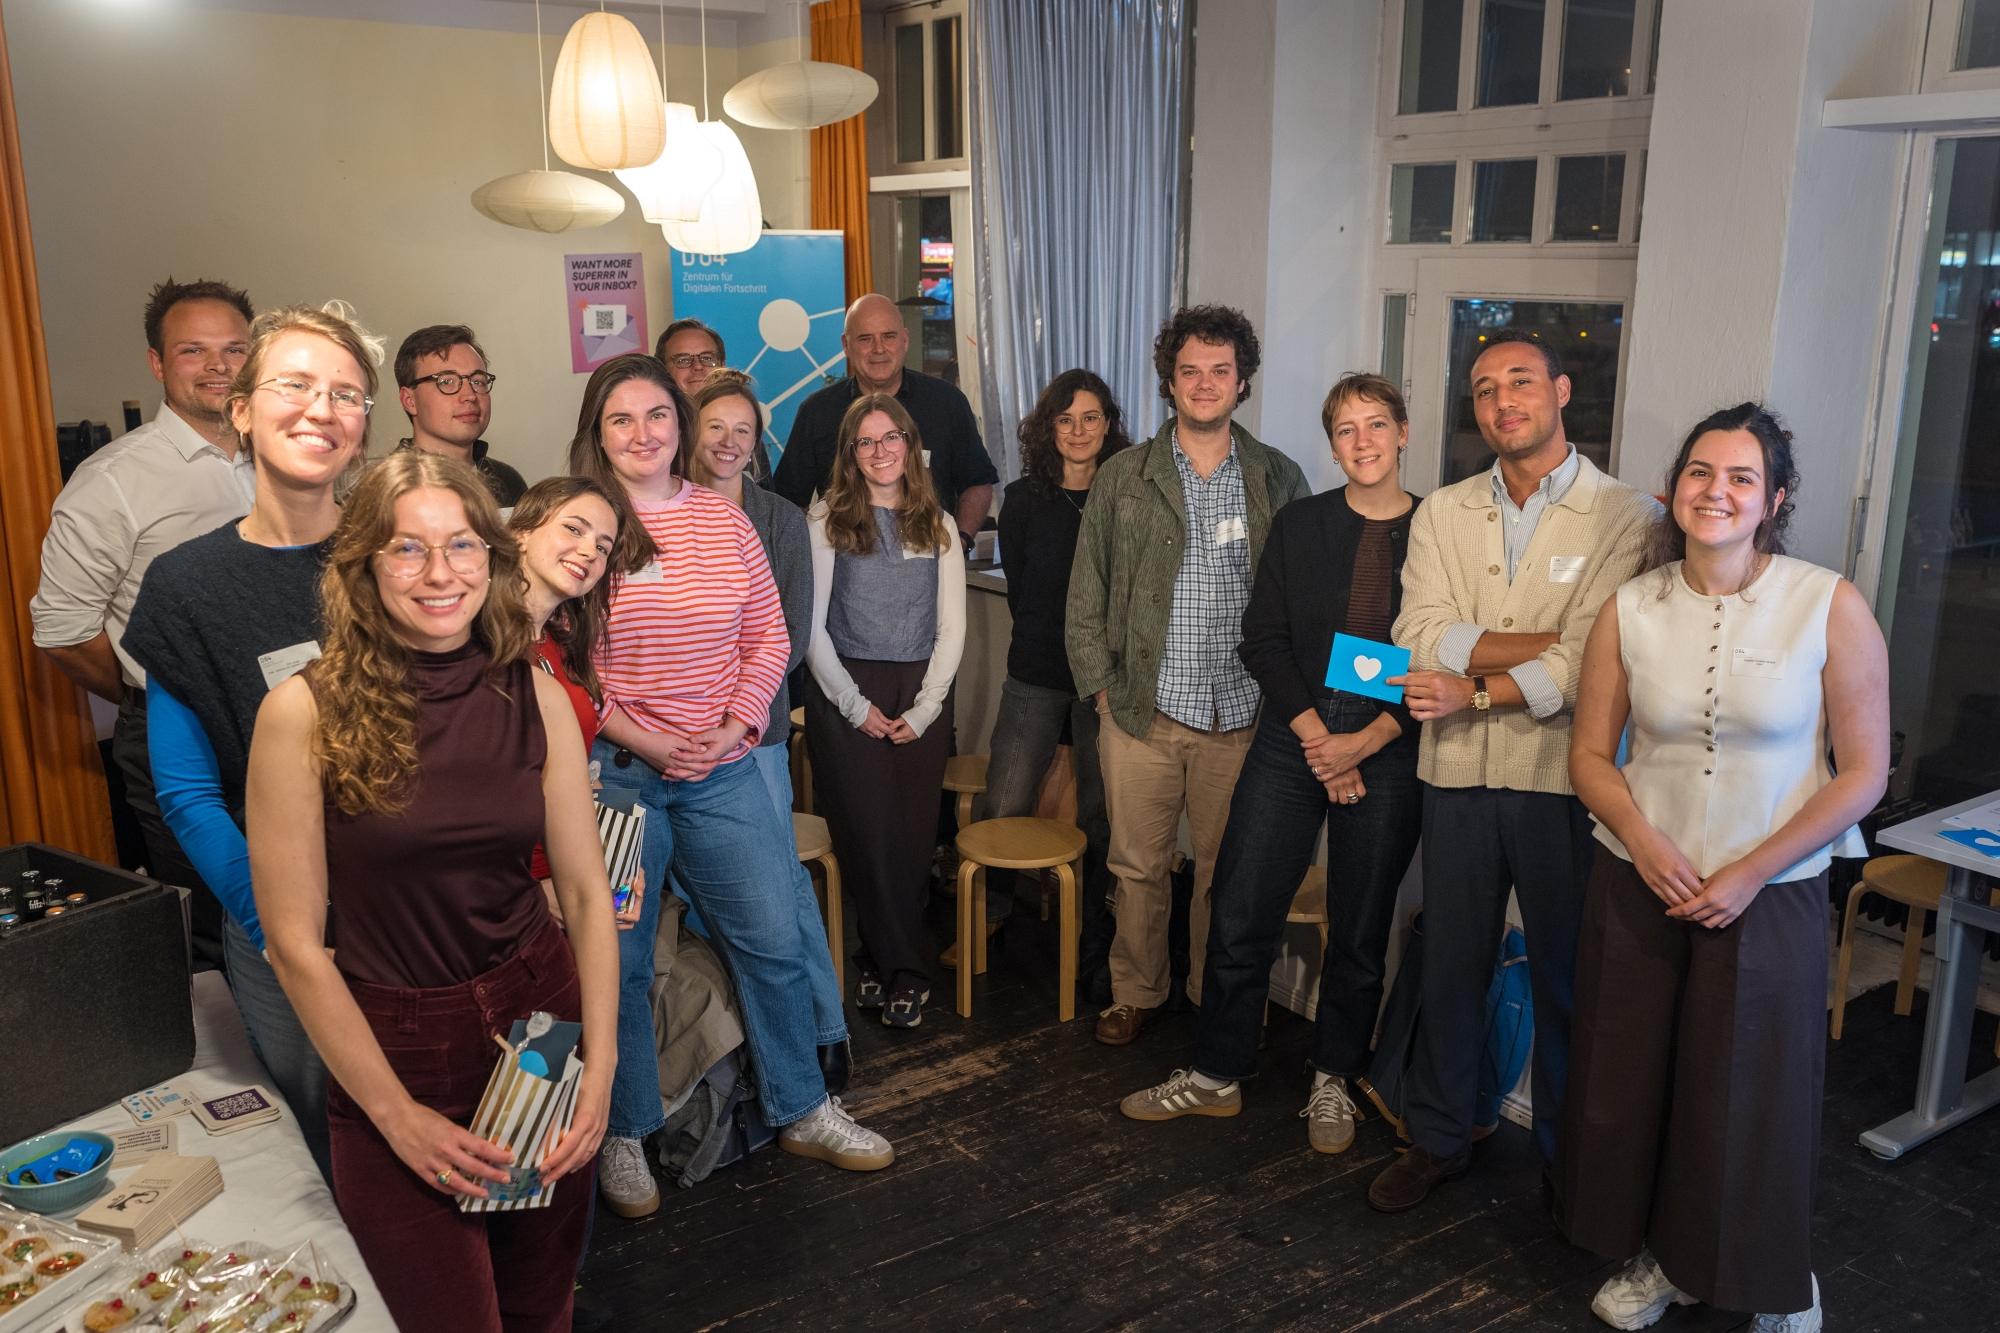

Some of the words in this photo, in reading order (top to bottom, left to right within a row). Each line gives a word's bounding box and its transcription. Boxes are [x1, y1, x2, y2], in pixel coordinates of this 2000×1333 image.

[571, 260, 601, 269] WANT
[604, 259, 632, 268] MORE
[572, 271, 615, 280] SUPERRR
[618, 270, 628, 279] IN
[682, 272, 719, 281] Zentrum
[721, 272, 733, 281] für
[573, 282, 600, 291] YOUR
[602, 281, 637, 290] INBOX?
[683, 283, 721, 293] Digitalen
[724, 283, 767, 293] Fortschritt
